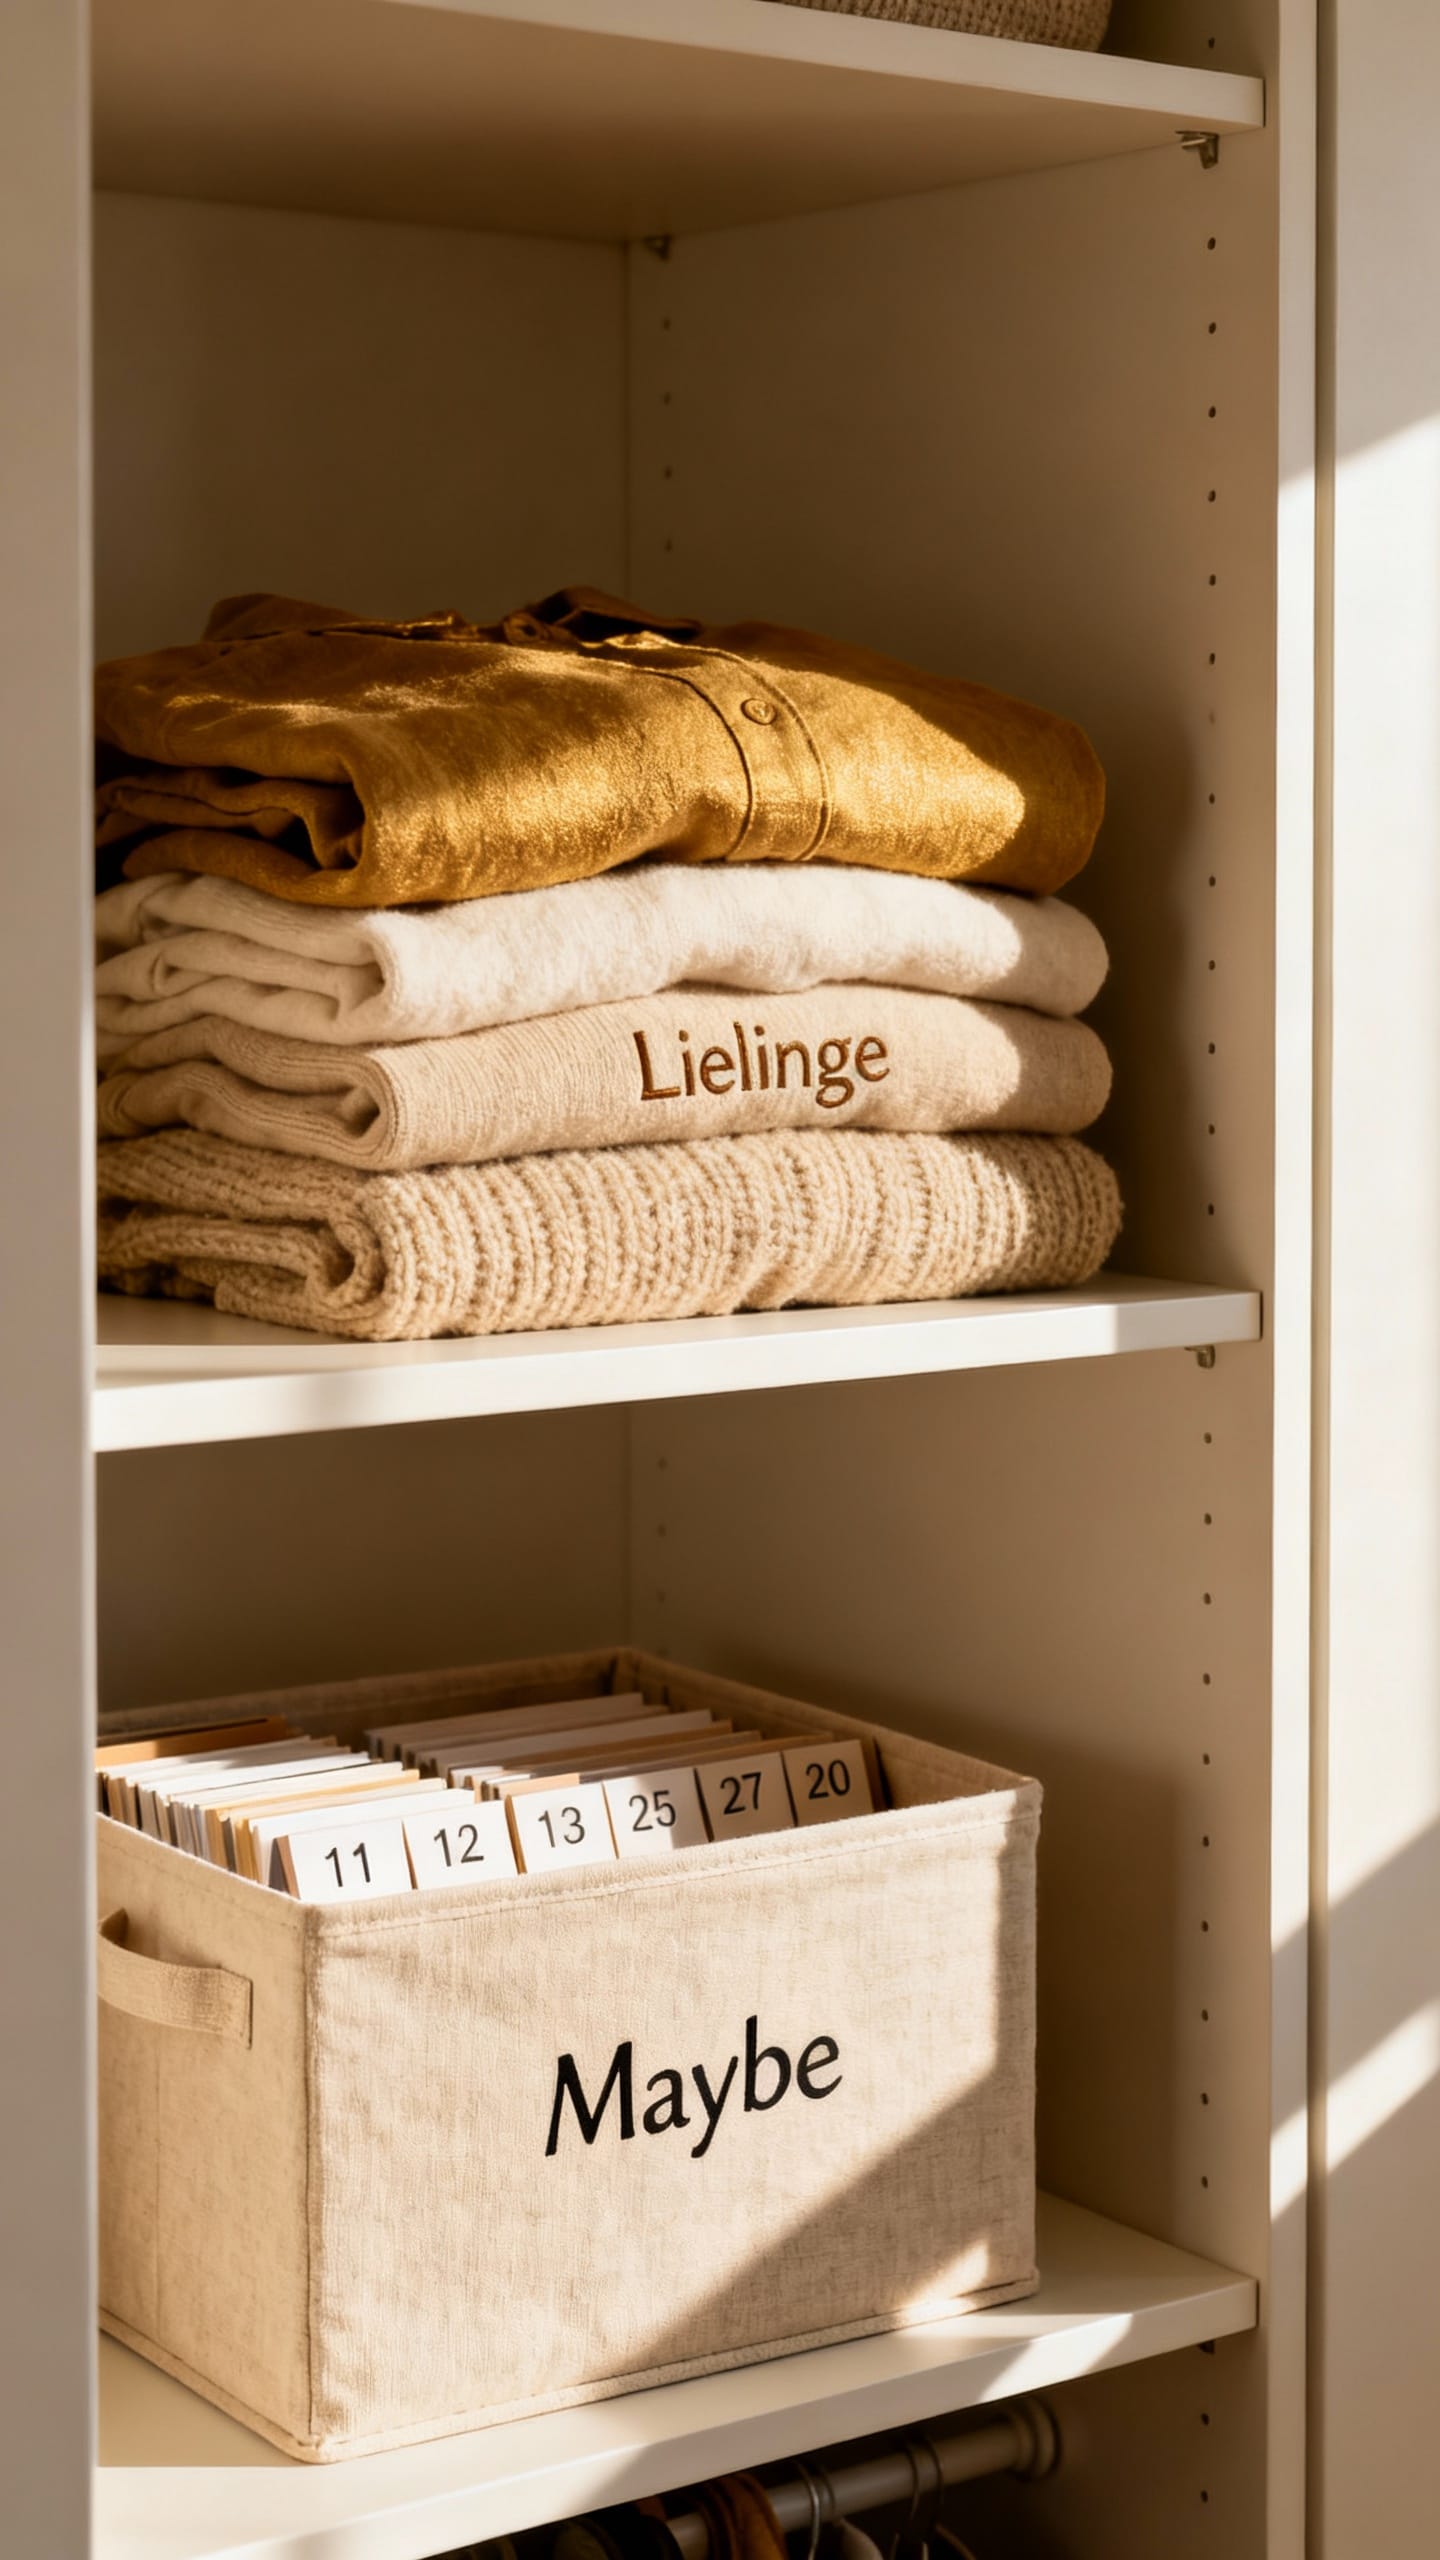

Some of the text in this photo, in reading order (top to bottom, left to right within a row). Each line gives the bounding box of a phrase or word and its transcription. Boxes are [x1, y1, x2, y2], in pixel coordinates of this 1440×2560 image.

[633, 1021, 890, 1108] Lielinge
[719, 1772, 762, 1815] 27
[806, 1759, 850, 1800] 20
[538, 1806, 585, 1848] 13
[628, 1790, 676, 1832] 25
[325, 1842, 371, 1887] 11
[433, 1824, 484, 1867] 12
[545, 2015, 843, 2158] Maybe
